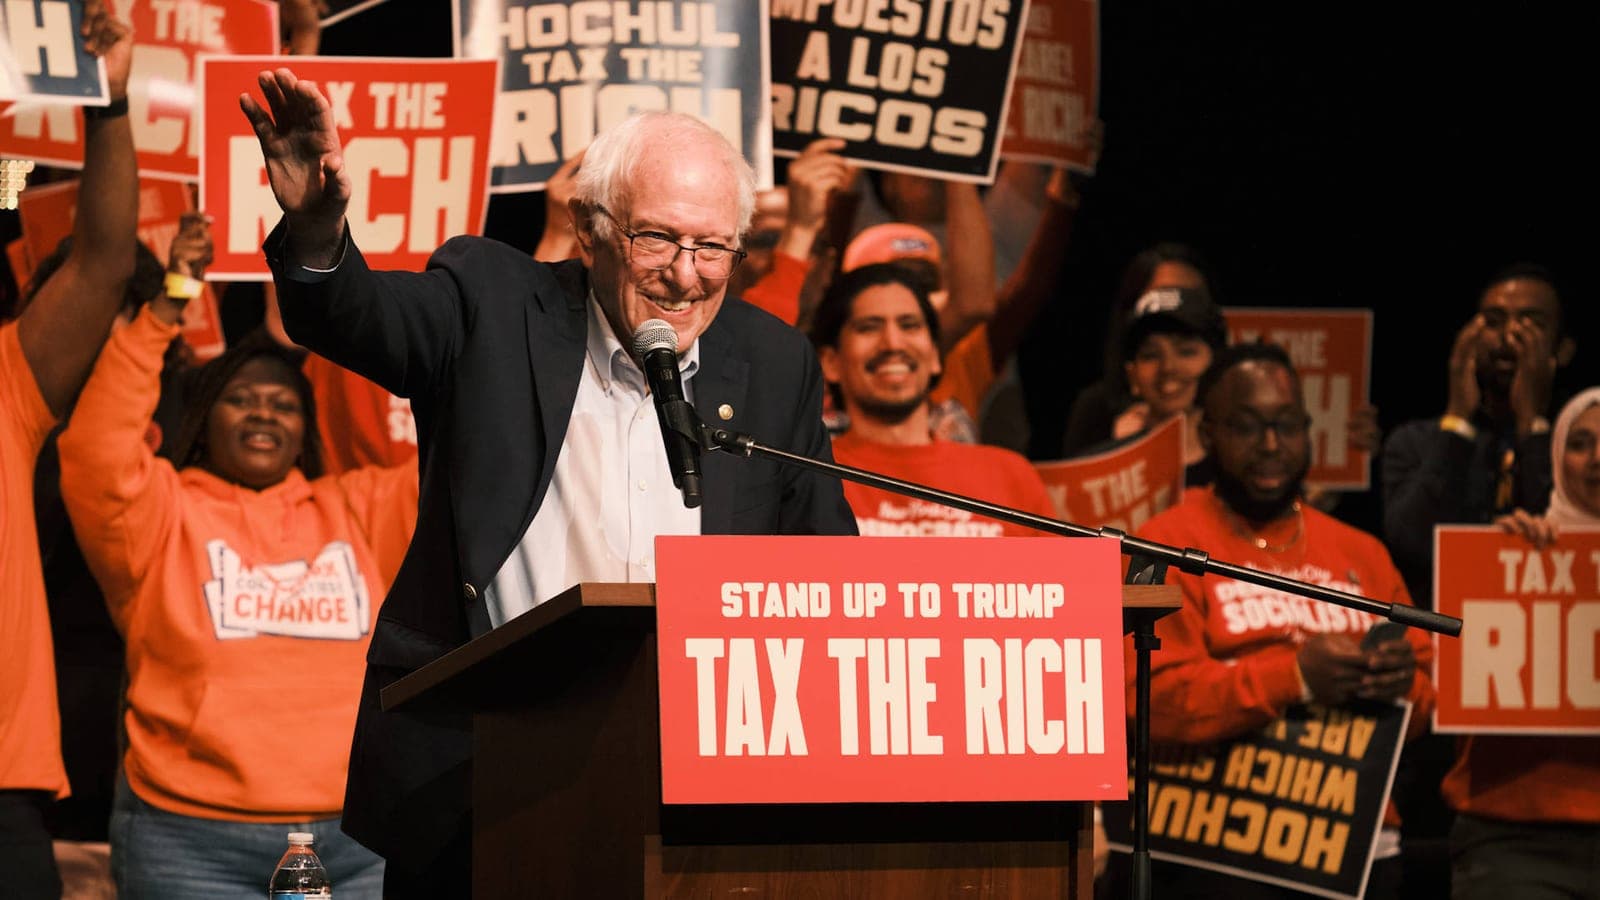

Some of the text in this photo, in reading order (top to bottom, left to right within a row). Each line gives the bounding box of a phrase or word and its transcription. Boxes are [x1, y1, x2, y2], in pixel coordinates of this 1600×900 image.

[493, 1, 741, 50] HOCHUL
[522, 47, 703, 84] TAX THE
[797, 30, 949, 98] A LOS
[369, 82, 448, 130] THE
[771, 82, 987, 157] RICOS
[228, 135, 476, 254] RCH
[1081, 459, 1150, 519] THE
[1498, 550, 1576, 594] TAX
[235, 593, 349, 623] CHANGE
[721, 582, 1065, 618] STAND UP TO TRUMP
[685, 637, 1105, 756] TAX THE RICH
[1221, 743, 1358, 816] WHICH
